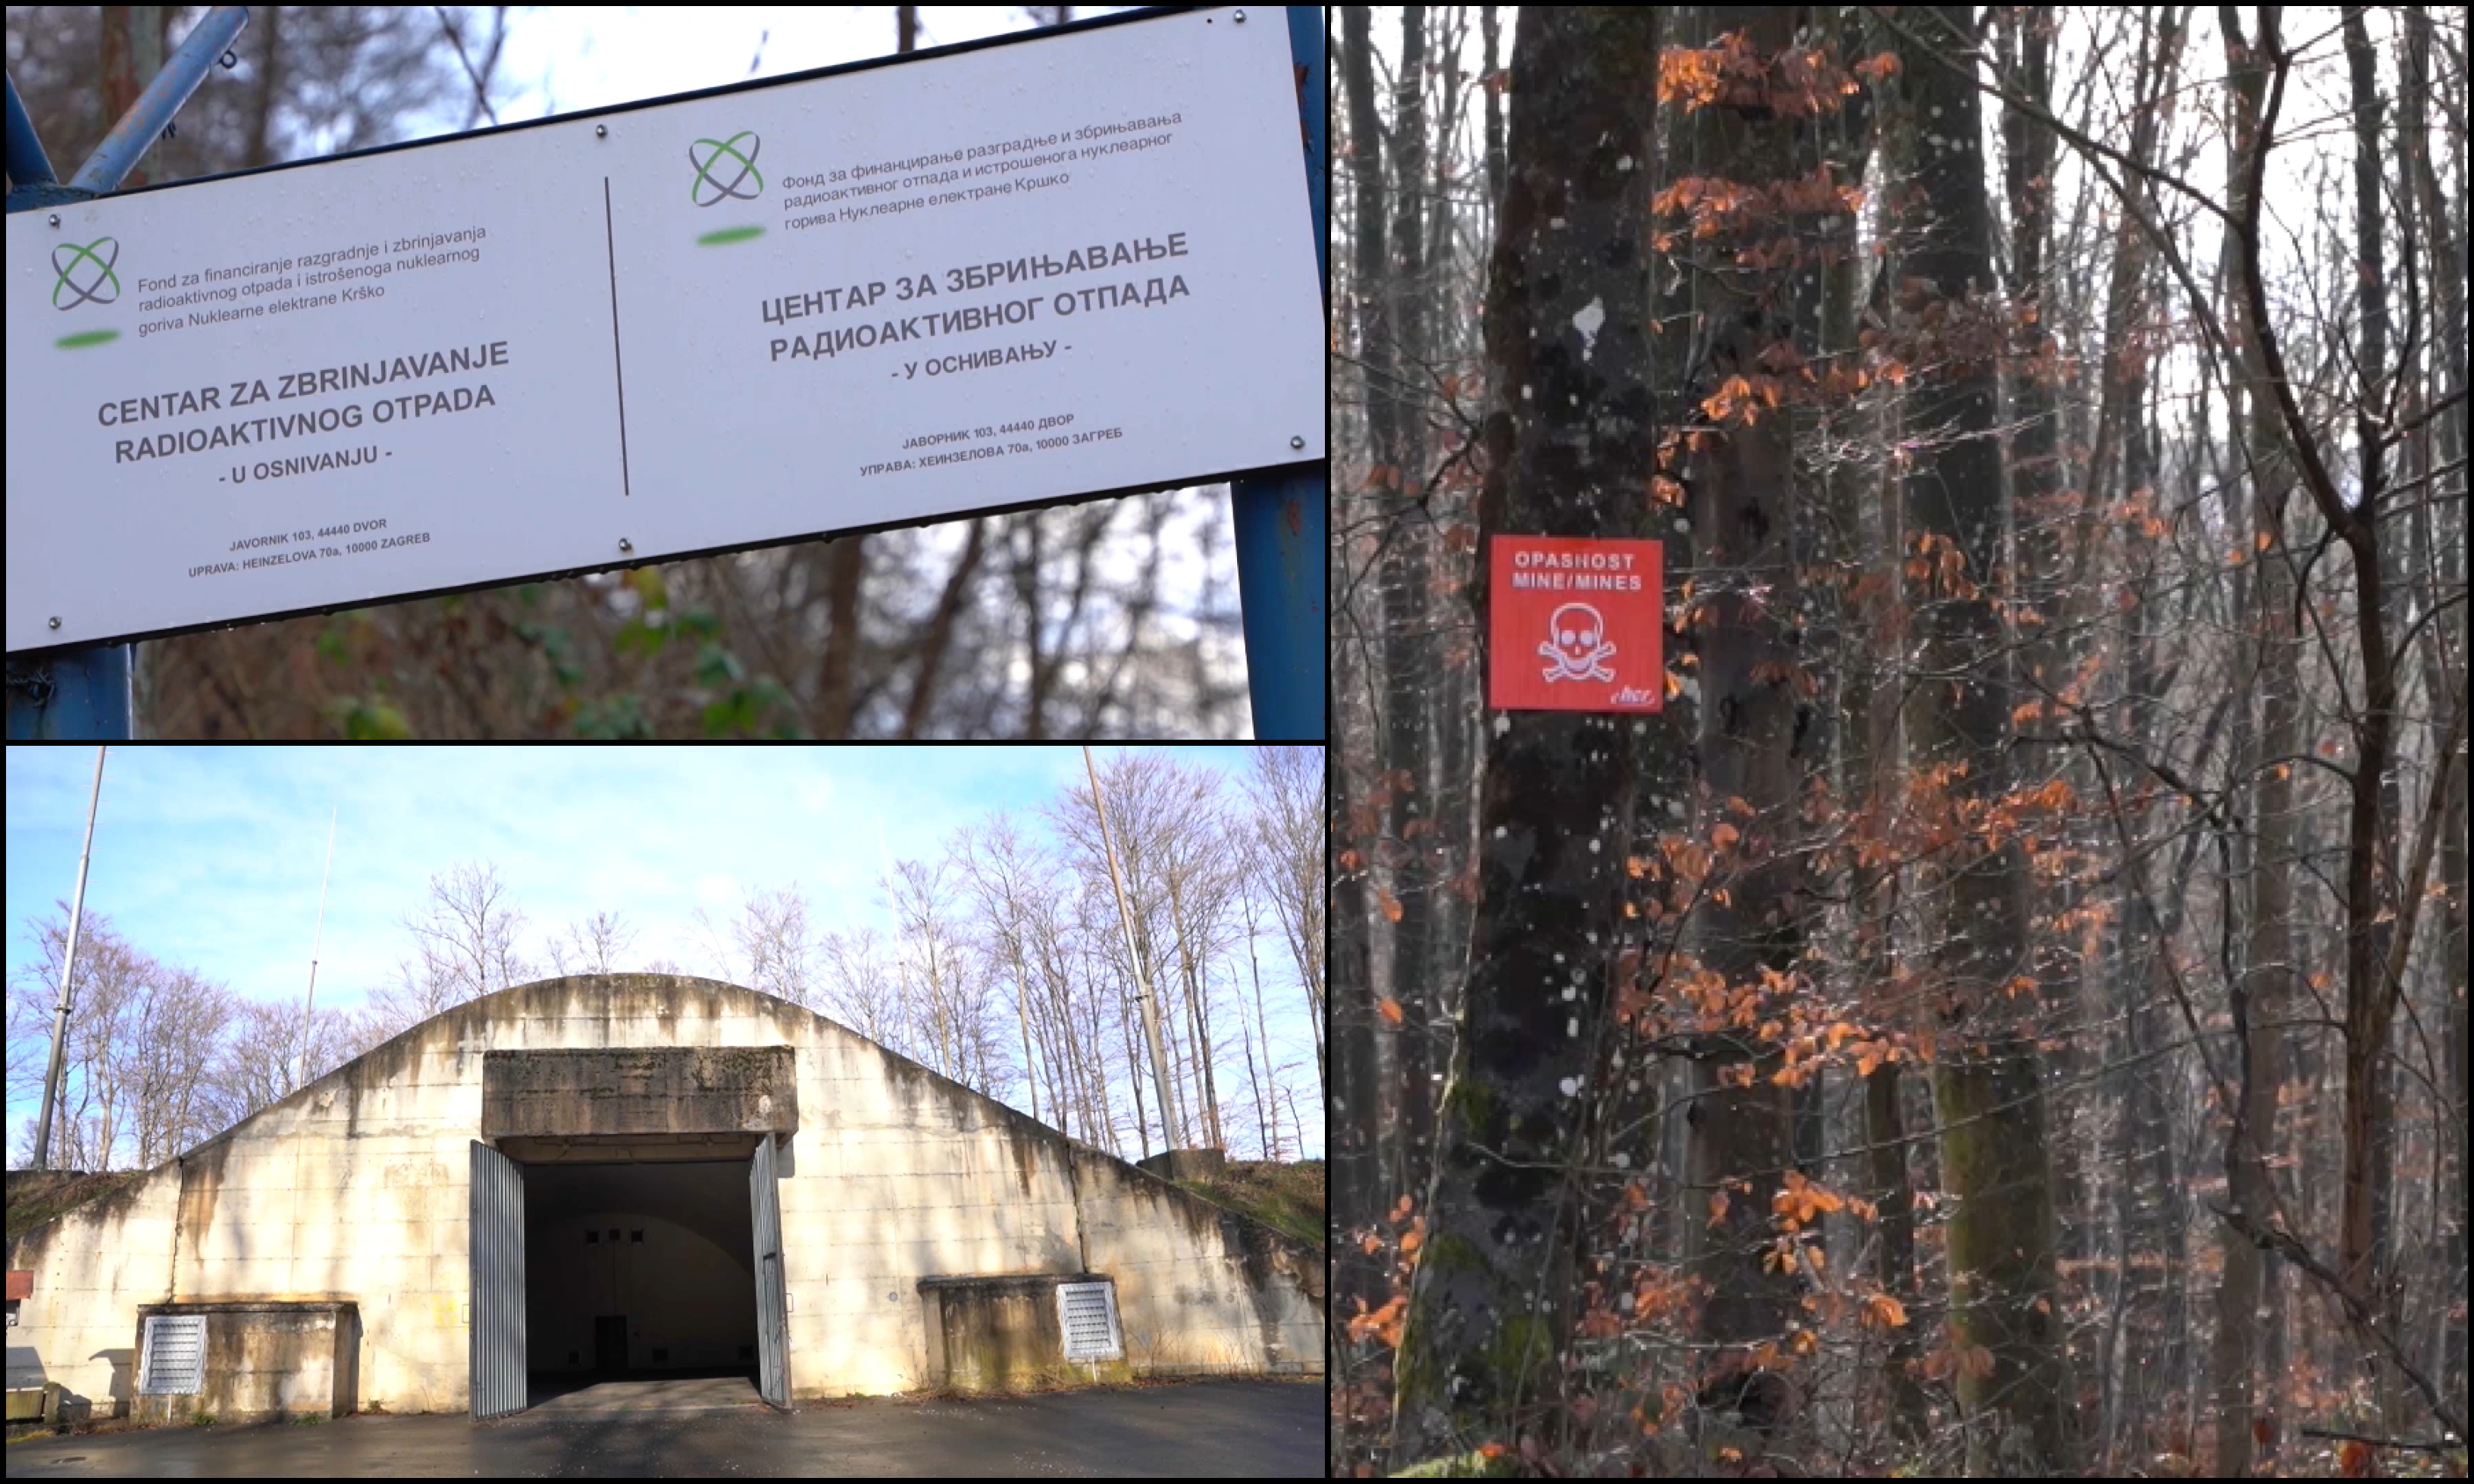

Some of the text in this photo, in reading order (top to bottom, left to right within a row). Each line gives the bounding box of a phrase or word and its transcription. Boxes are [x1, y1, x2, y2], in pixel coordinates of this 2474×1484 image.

[781, 112, 1182, 189] Фонд за финанцирање разградње и збрињавања
[784, 133, 1173, 211] радиоактивног отпада и истрошенога нуклеарног
[784, 173, 1070, 230] горива Нуклеарне електране Кршко
[137, 226, 487, 293] Fond za financiranje razgradnje i zbrinjavanja
[139, 248, 480, 312] radioaktivnog otpada i istrošenoga nuklearnog
[761, 231, 1189, 327] ЦЕНТАР ЗА ЗБРИЊАВАЊЕ
[138, 285, 385, 338] goriva Nuklearne elektrane Krško
[770, 274, 1191, 362] РАДИОАКТИВНОГ ОТПАДА
[97, 340, 509, 427] CENTAR ZA ZBRINJAVANJE
[903, 361, 919, 380] У
[925, 339, 1057, 377] ОСНИВАЊУ
[115, 384, 496, 465] RADIOAKTIVNOG OTPADA
[860, 427, 1123, 477] УПРАВА: ХЕИНЗЕЛОВА 70а, 10000 ЗАГРЕБ
[902, 413, 1075, 450] ЈАВОРНИК 103, 44440 ДВОР
[232, 465, 246, 484] U
[252, 445, 377, 481] OSNIVANJU
[188, 531, 431, 578] UPRAVA: HEINZELOVA 70a, 10000 ZAGREB
[229, 518, 387, 552] JAVORNIK 103, 44440 DVOR
[1512, 572, 1642, 590] MINE/MINES
